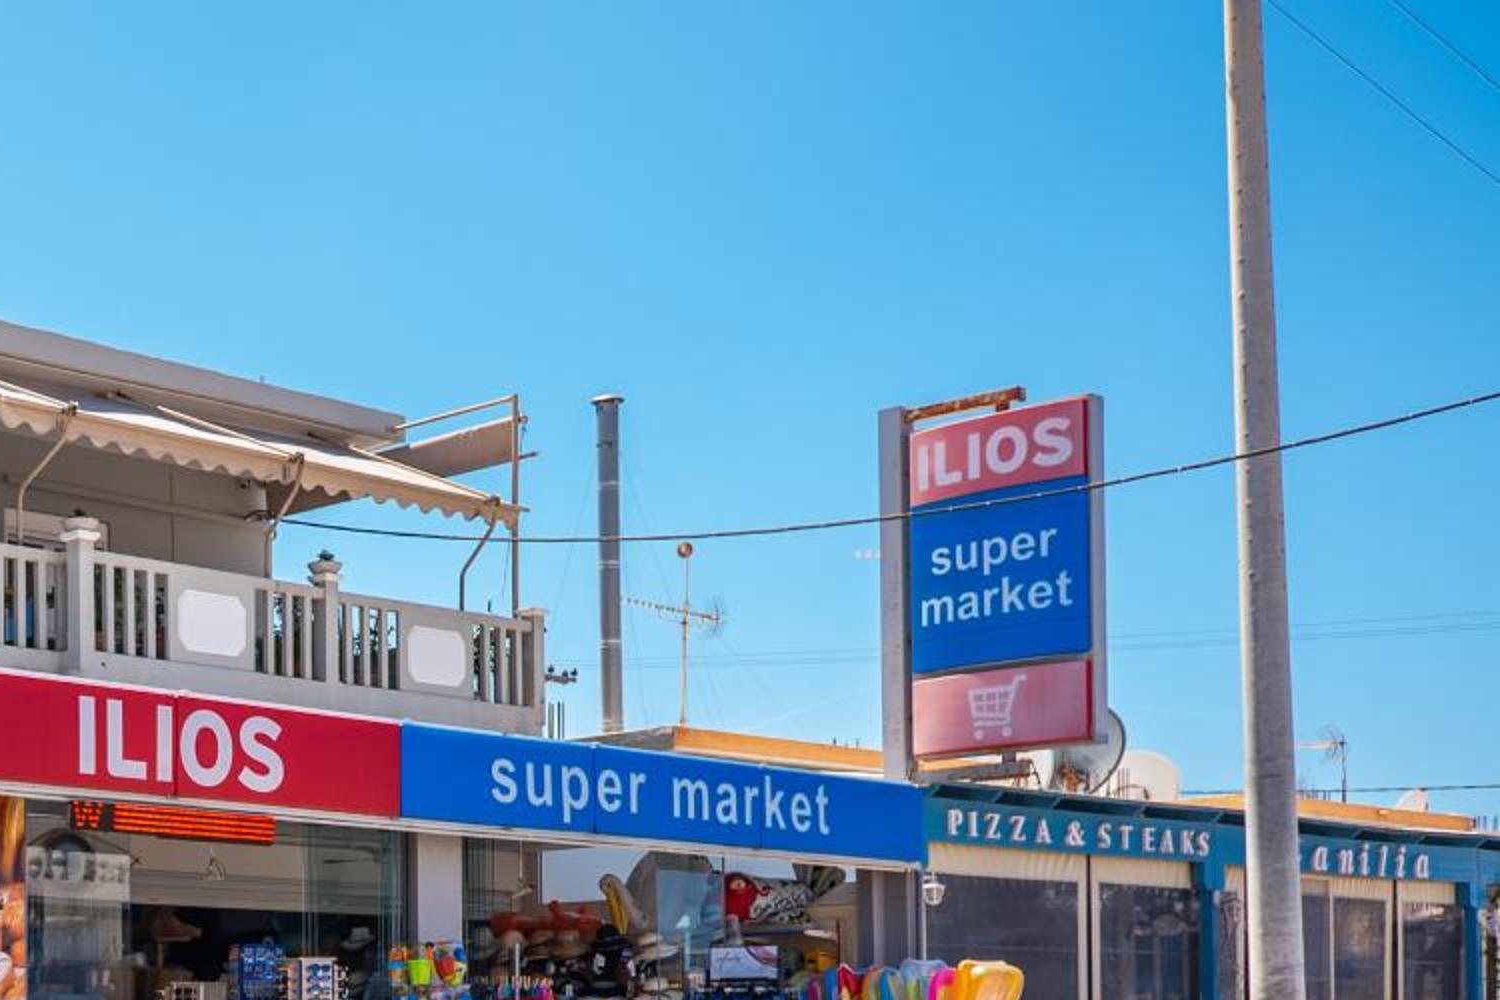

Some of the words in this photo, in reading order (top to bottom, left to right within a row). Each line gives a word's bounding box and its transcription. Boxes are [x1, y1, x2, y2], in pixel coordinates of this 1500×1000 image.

[917, 416, 1074, 492] ILIOS
[931, 527, 1057, 577] super
[920, 569, 1073, 628] market
[77, 694, 285, 794] ILIOS
[490, 756, 647, 825] super
[672, 774, 831, 836] market
[947, 809, 1053, 844] PIZZA
[1064, 820, 1086, 847] &
[1097, 822, 1211, 857] STEAKS
[1299, 840, 1430, 880] anilia
